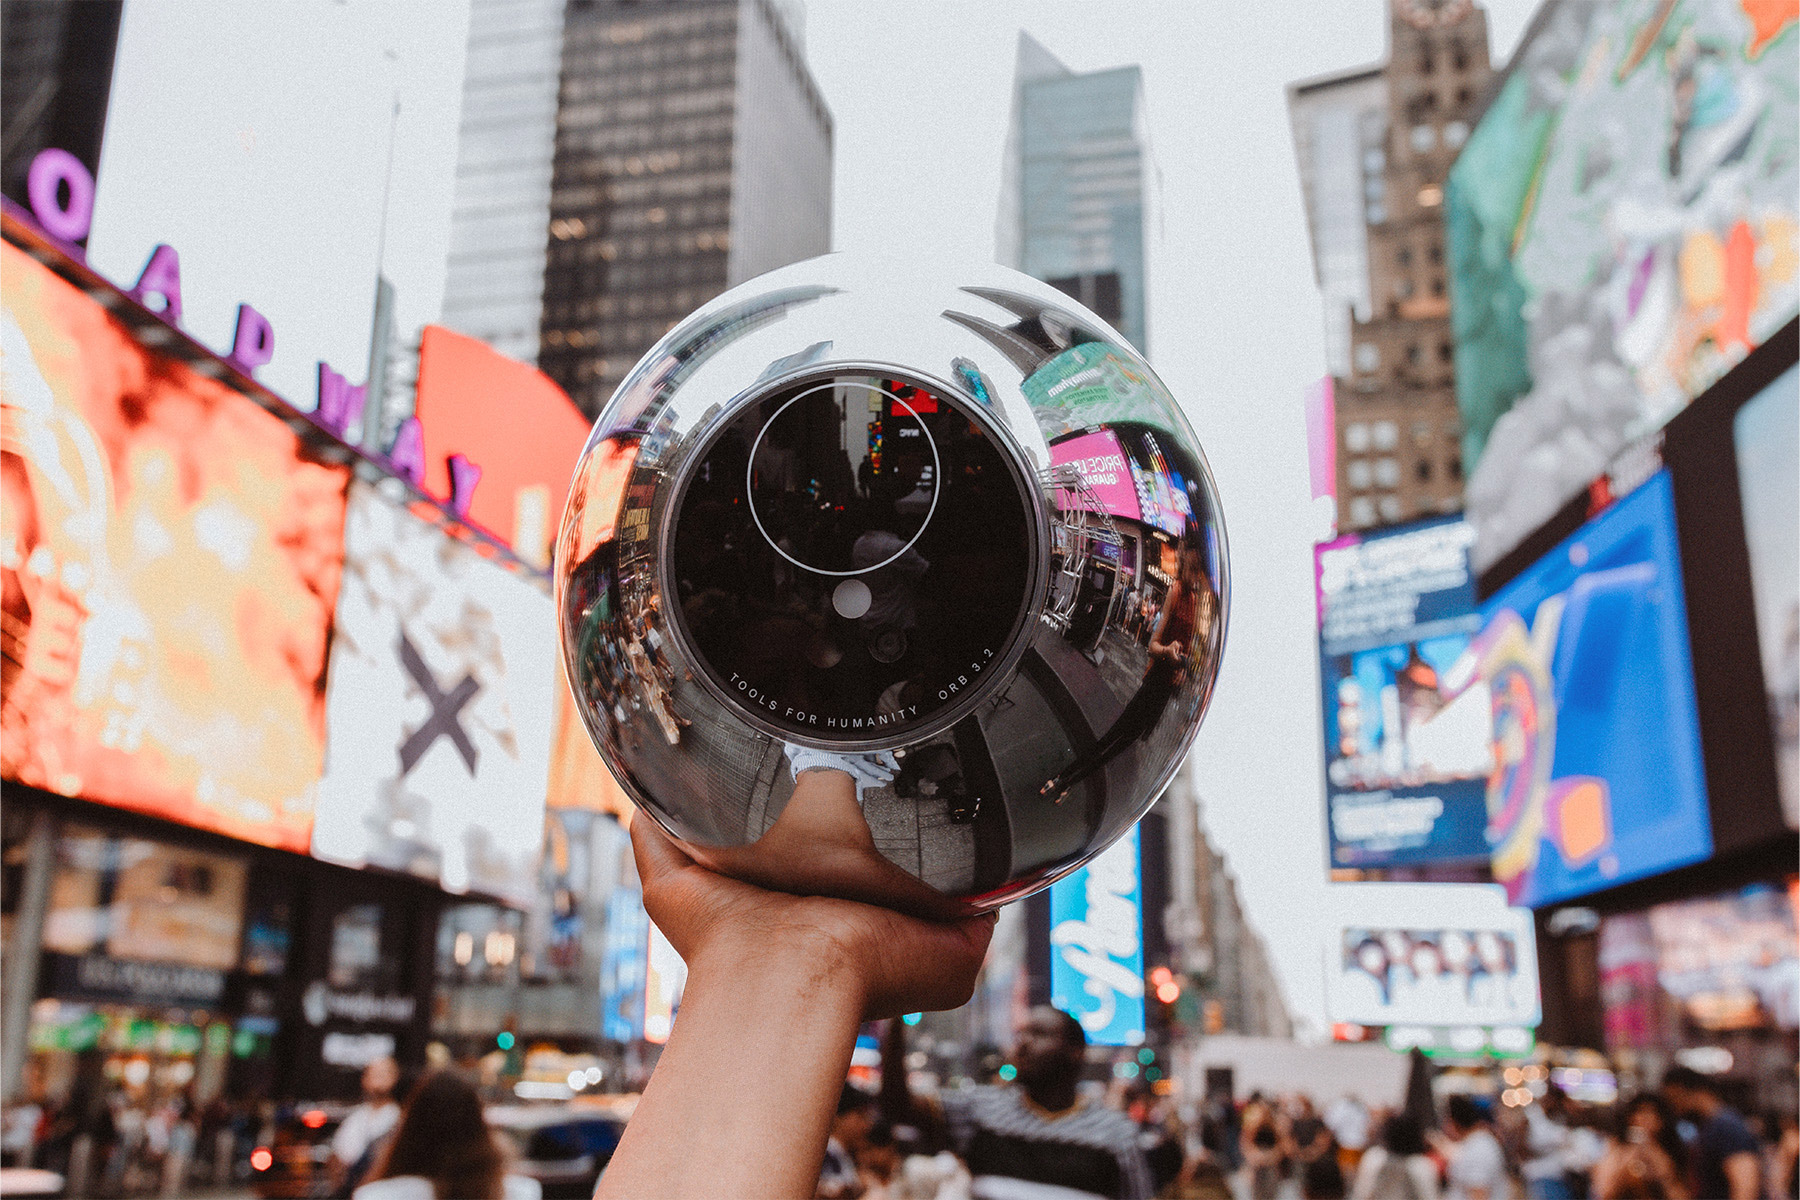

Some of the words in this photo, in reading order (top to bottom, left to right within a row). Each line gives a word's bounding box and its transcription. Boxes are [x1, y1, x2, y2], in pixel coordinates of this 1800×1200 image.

[729, 672, 777, 711] TOOLS
[785, 706, 818, 725] FOR
[827, 705, 918, 728] HUMANITY
[938, 675, 968, 701] ORB
[971, 647, 994, 672] 3.2
